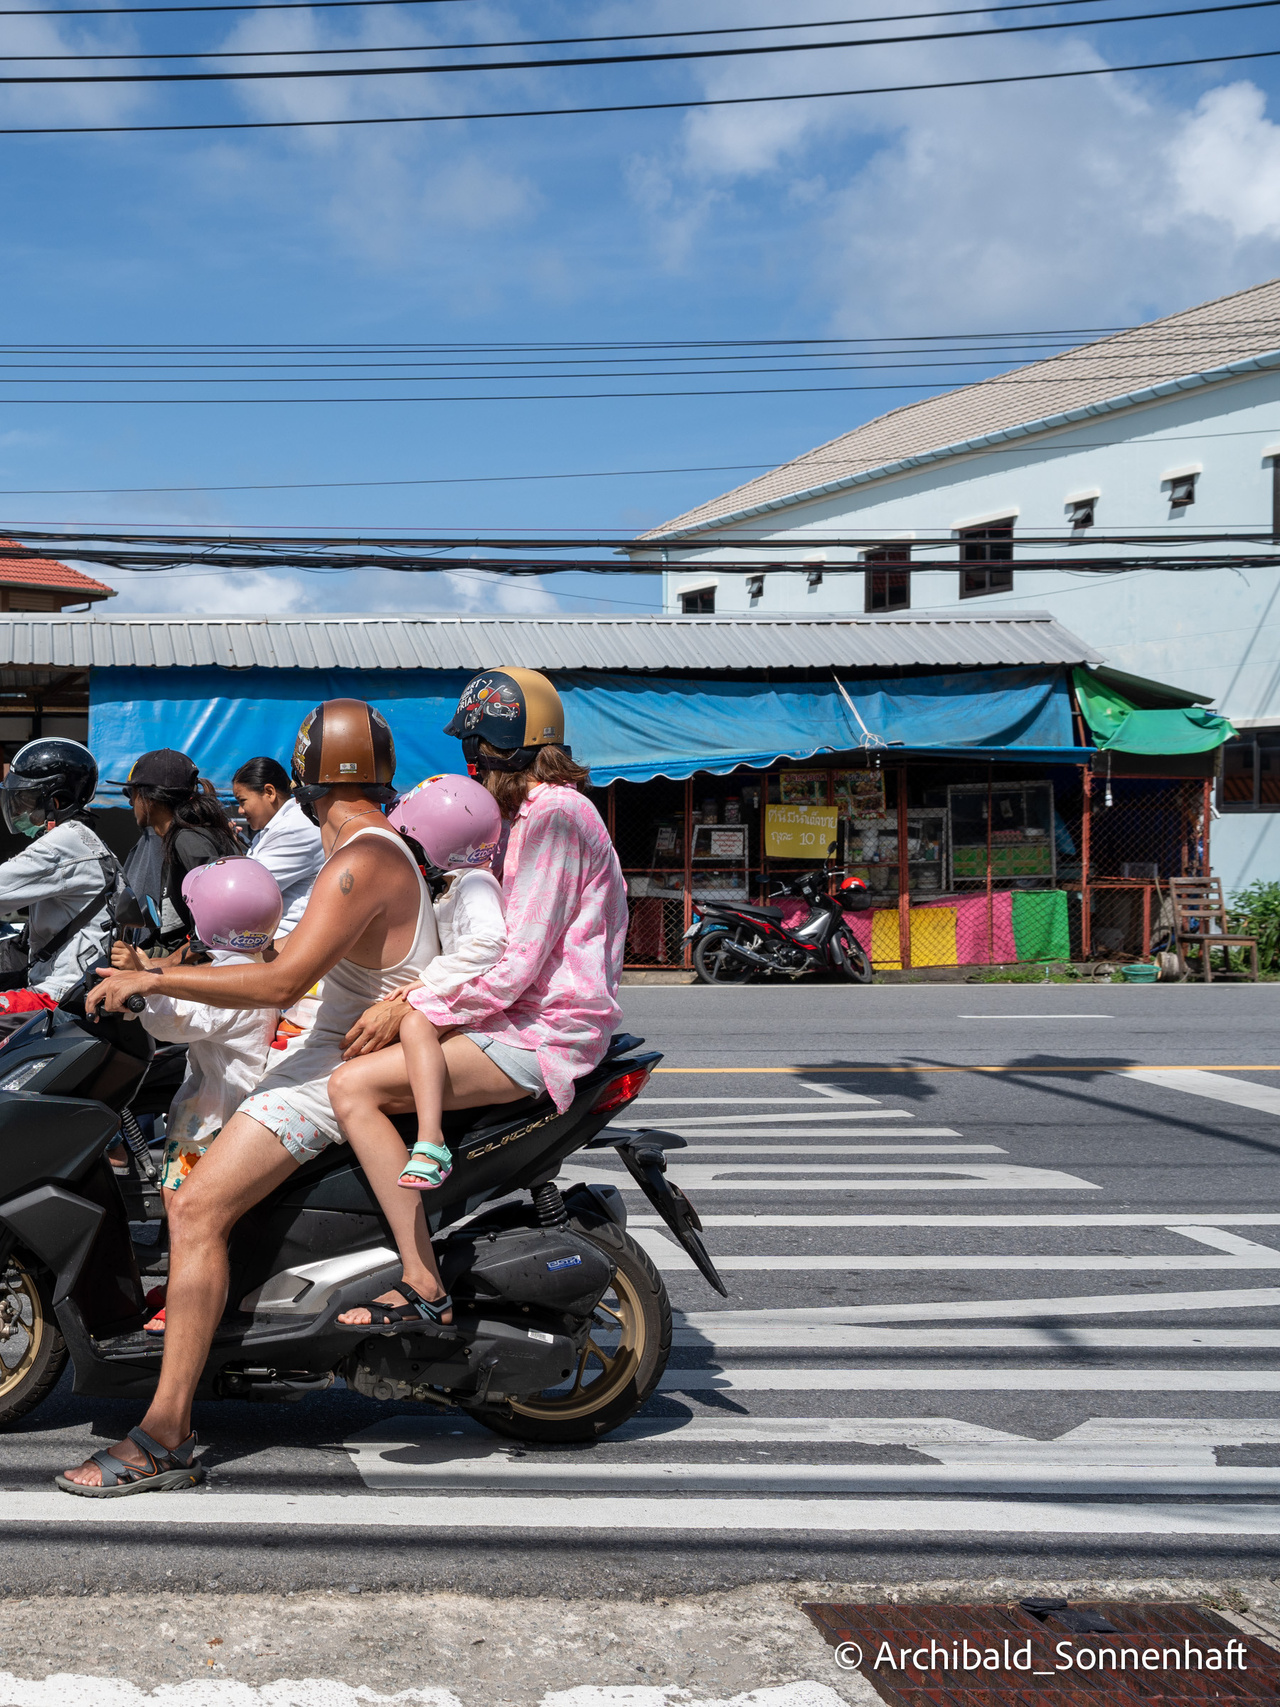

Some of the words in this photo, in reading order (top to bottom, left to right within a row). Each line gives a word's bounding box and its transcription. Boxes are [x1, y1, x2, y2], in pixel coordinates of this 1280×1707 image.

[799, 832, 816, 845] 10
[233, 936, 268, 946] KIDDY
[466, 1118, 546, 1160] CLICK
